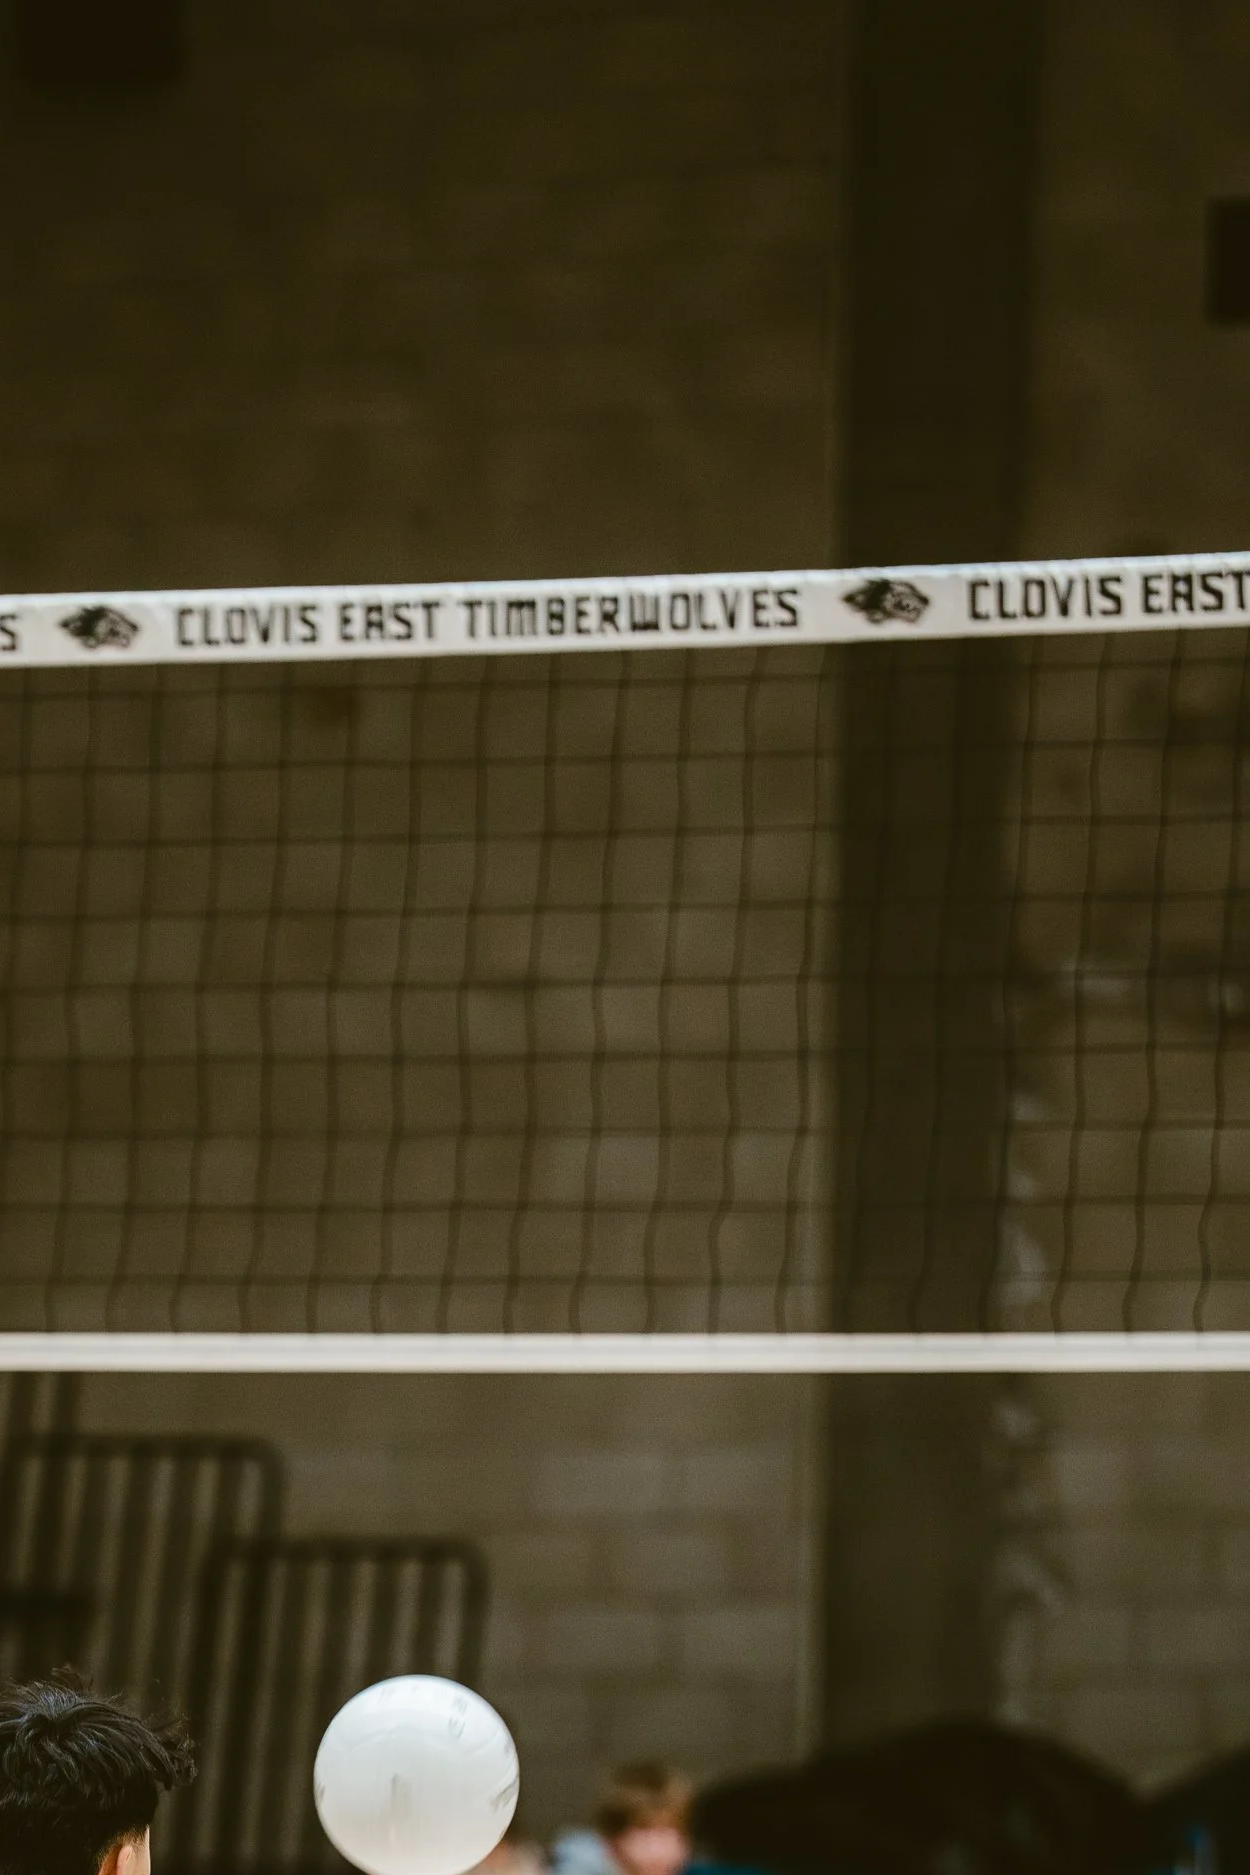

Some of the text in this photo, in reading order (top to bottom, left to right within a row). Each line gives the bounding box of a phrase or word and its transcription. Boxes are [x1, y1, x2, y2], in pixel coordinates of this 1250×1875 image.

[176, 588, 799, 647] CLOVIS EAST TIMBERWOLVES
[968, 568, 1250, 621] CLOVIS EAST
